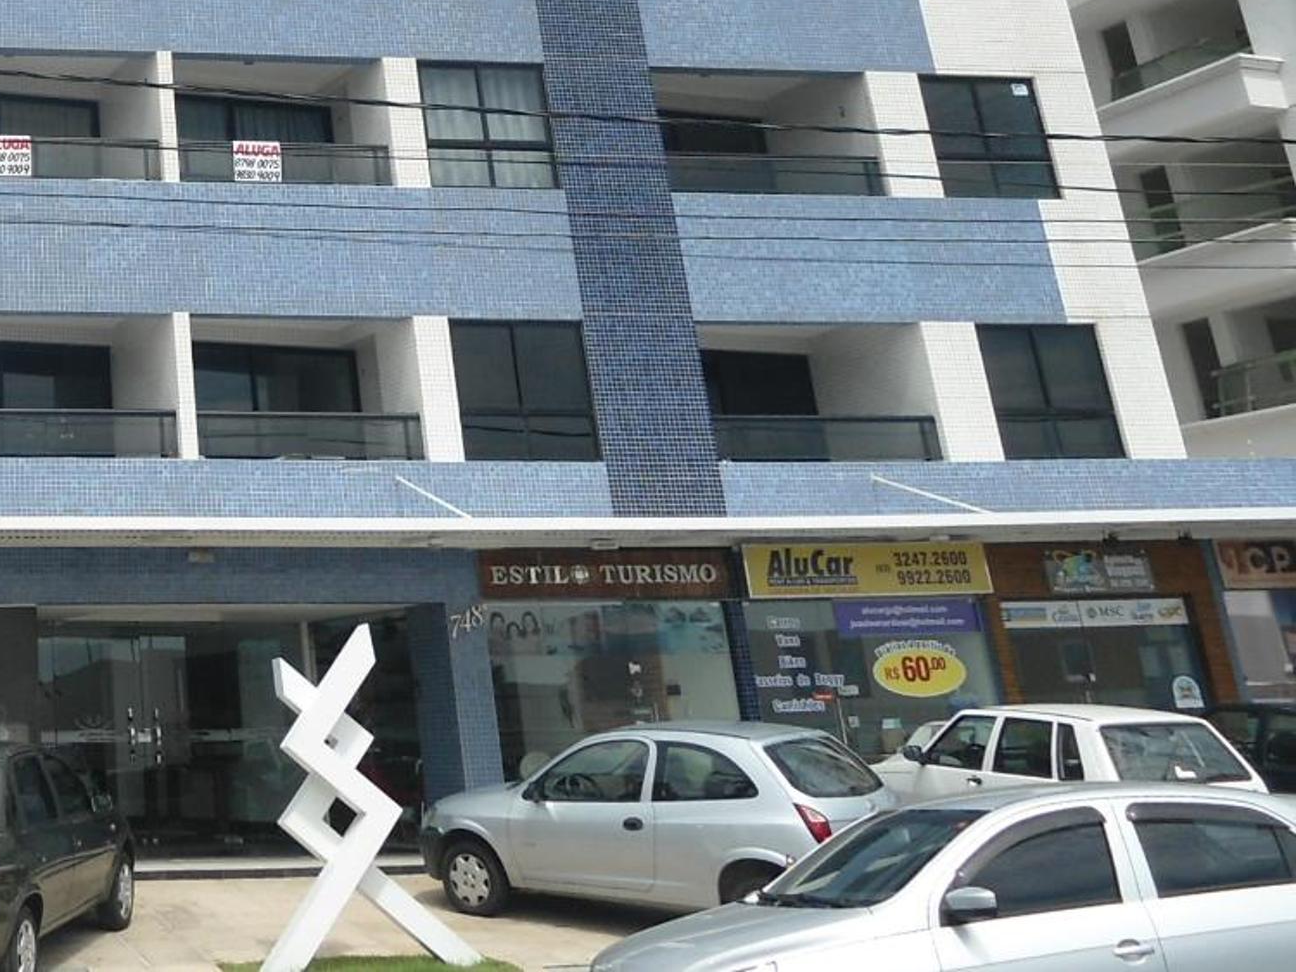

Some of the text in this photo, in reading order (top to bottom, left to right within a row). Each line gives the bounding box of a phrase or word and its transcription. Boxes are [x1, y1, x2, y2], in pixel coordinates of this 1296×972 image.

[234, 144, 279, 156] ALUGA
[768, 548, 853, 578] AluCar
[599, 563, 717, 584] TURISMO
[885, 666, 901, 681] R$
